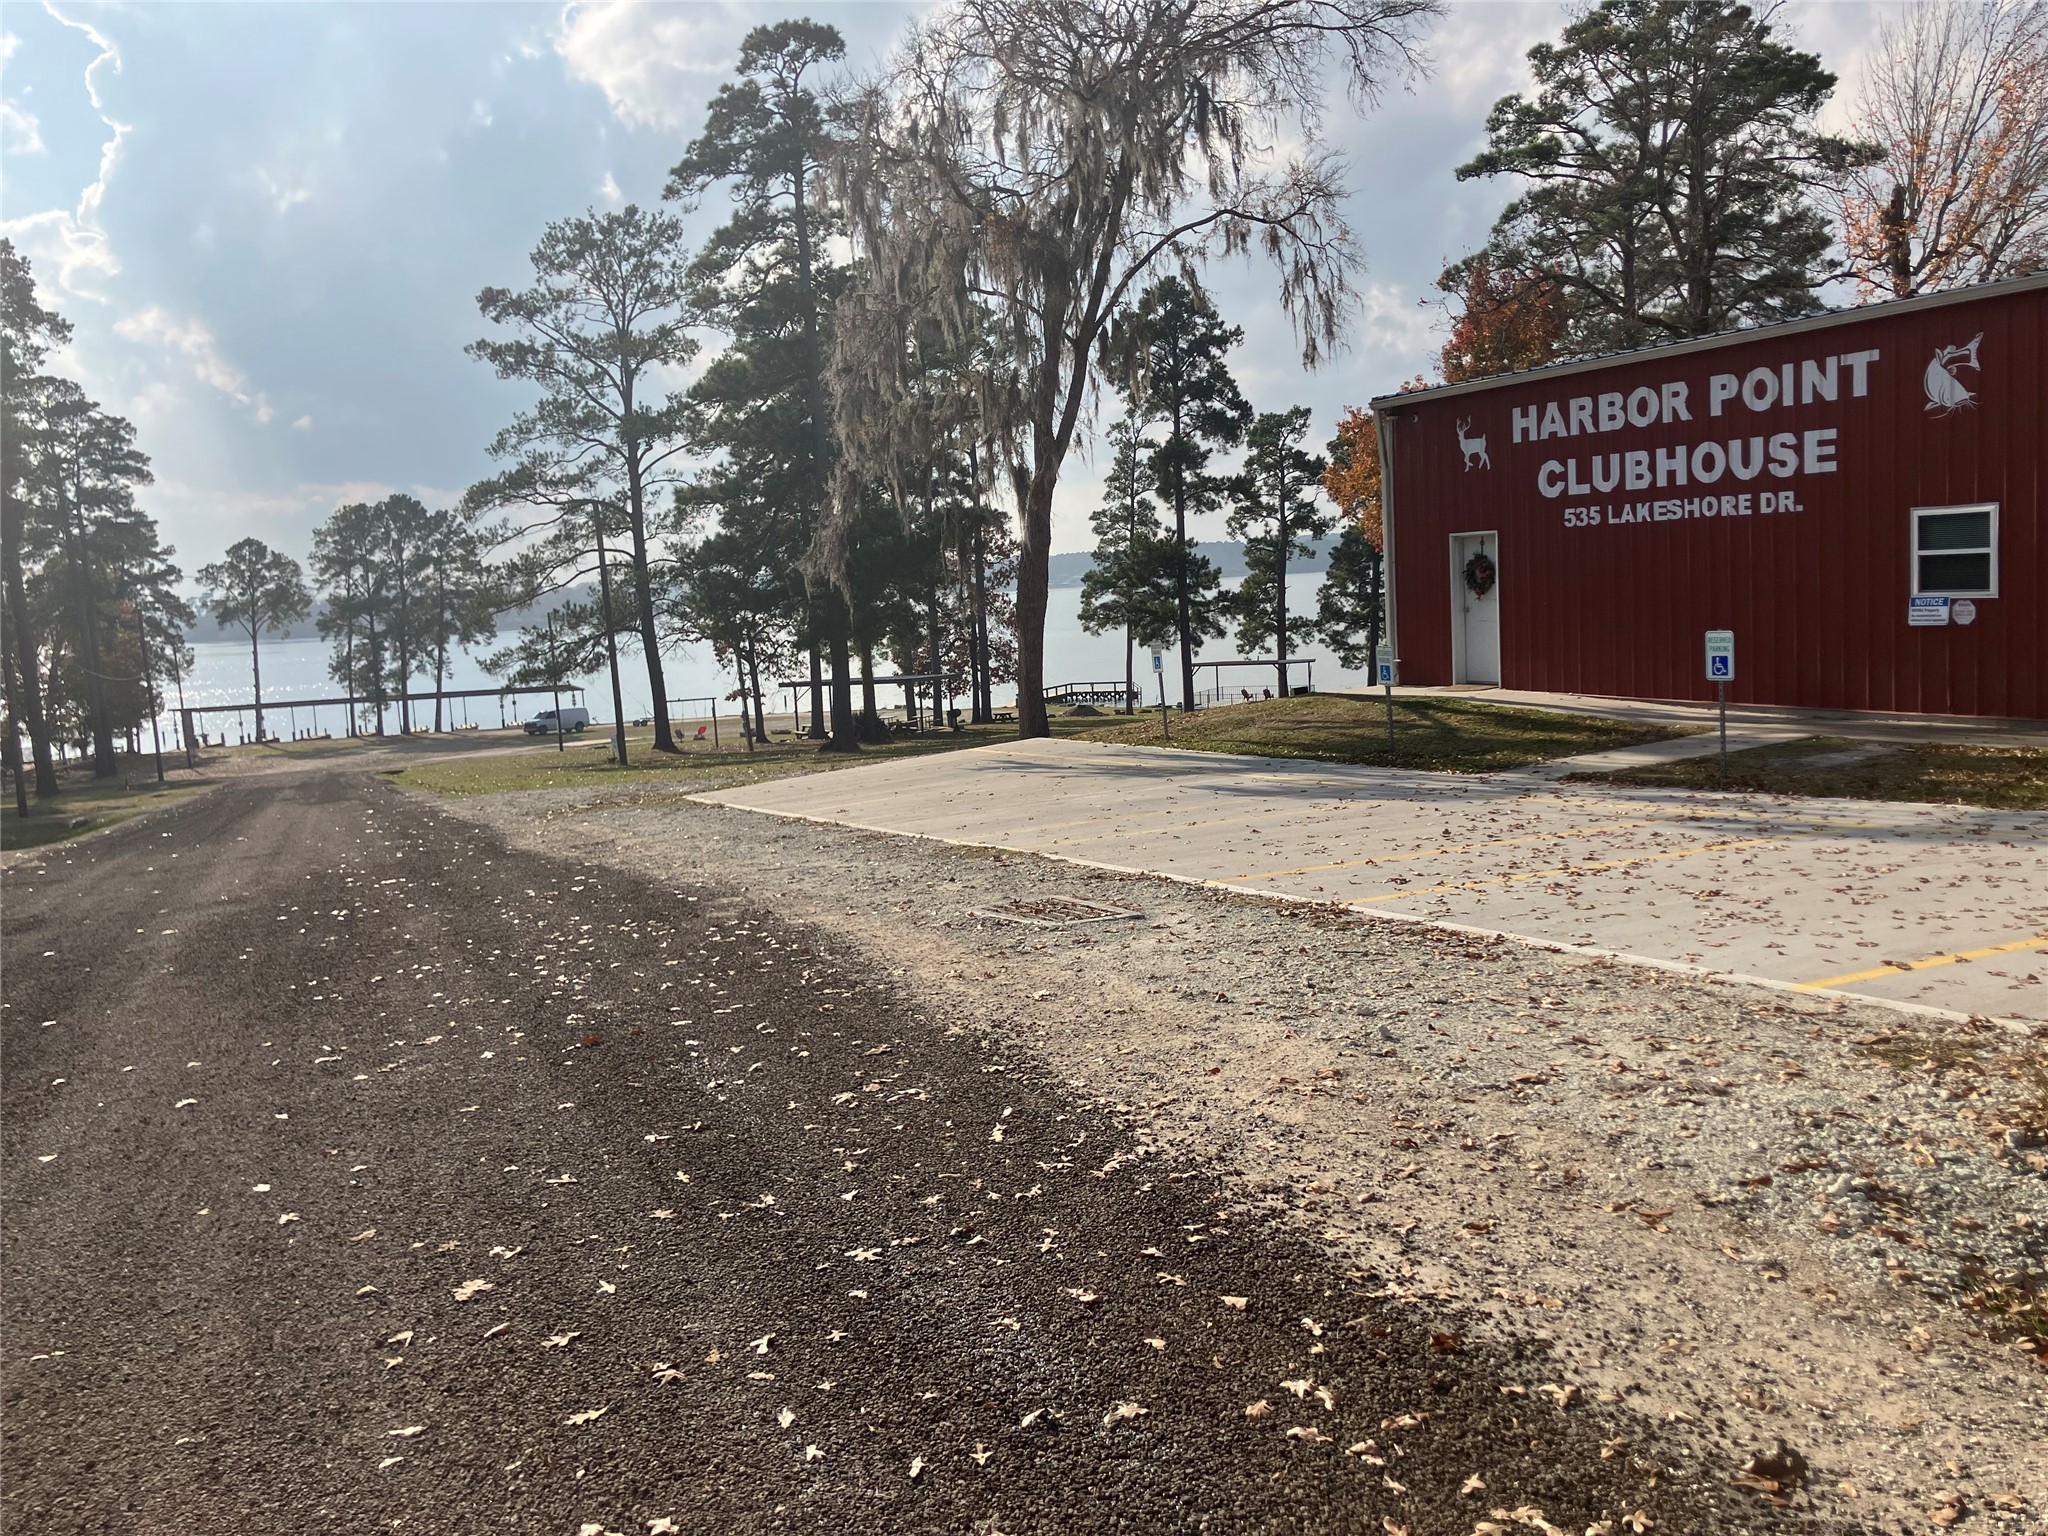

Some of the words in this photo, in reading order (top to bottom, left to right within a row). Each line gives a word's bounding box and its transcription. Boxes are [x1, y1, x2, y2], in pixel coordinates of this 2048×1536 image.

[1512, 381, 1694, 444] HARBOR
[1709, 349, 1880, 417] POINT
[1537, 428, 1838, 498] CLUBHOUSE
[1563, 506, 1601, 528] 535
[1608, 493, 1752, 525] LAKESHORE
[1759, 490, 1804, 515] DR.
[1914, 597, 1945, 606] NOTICE
